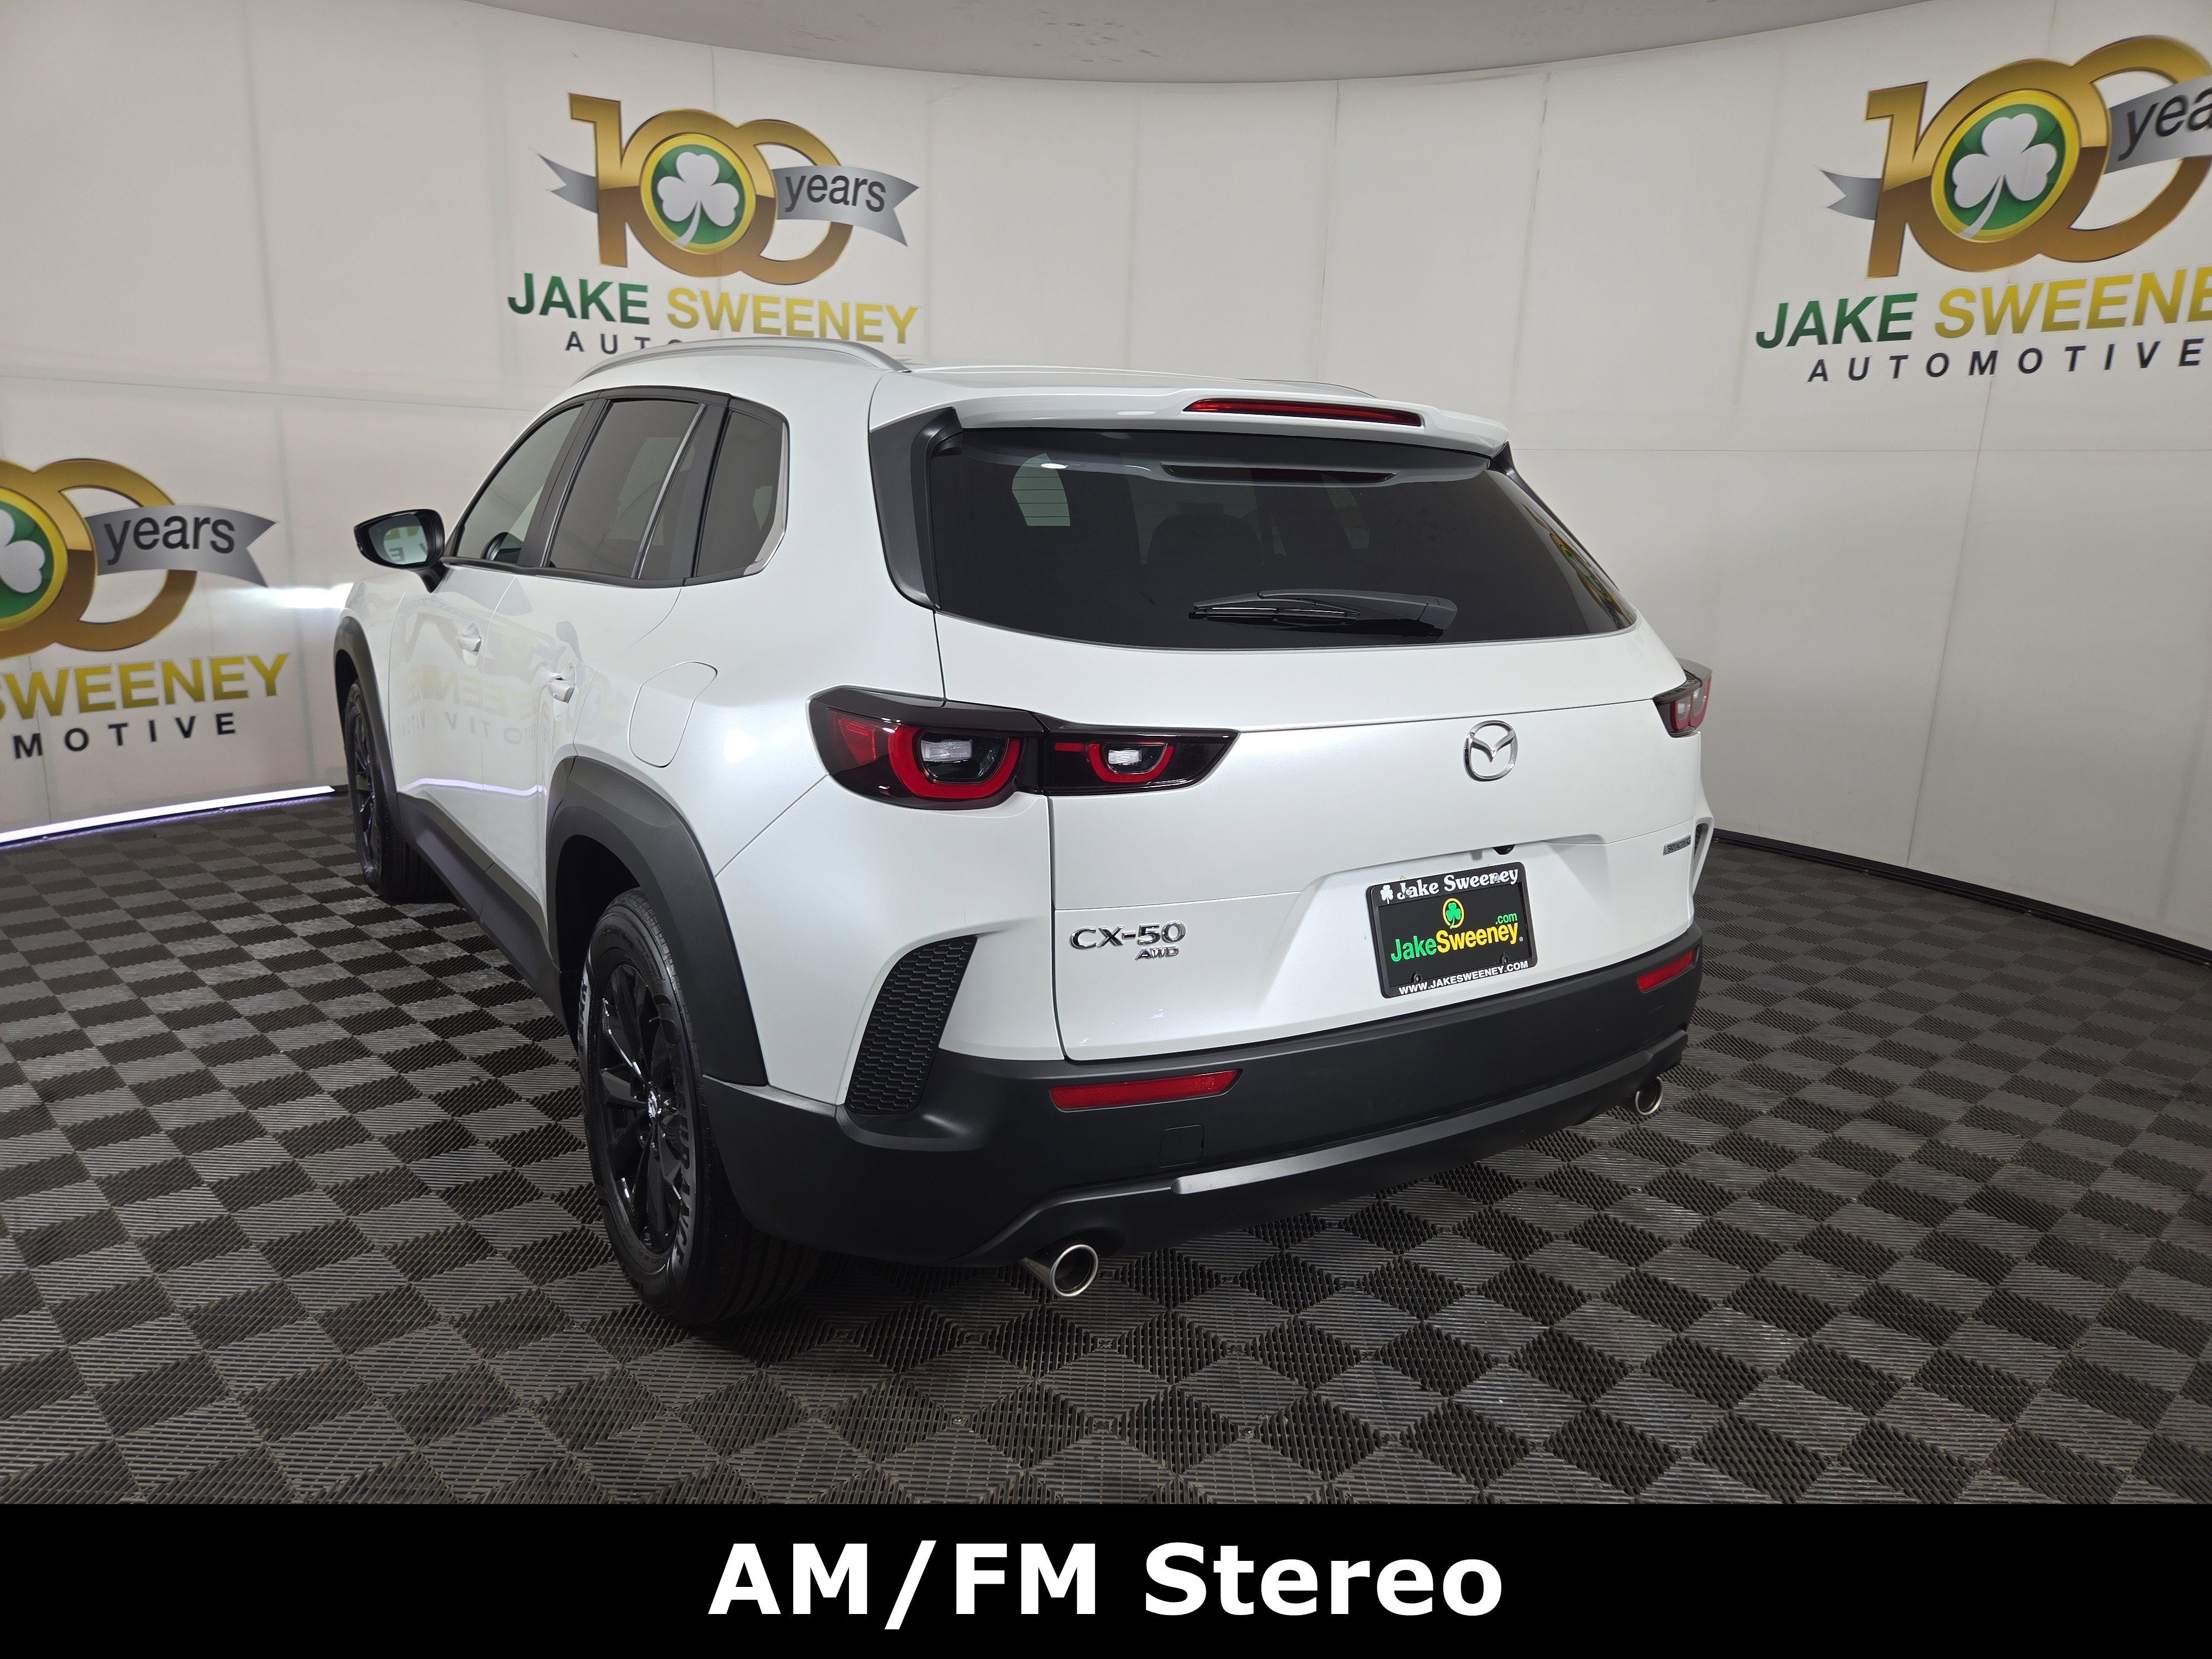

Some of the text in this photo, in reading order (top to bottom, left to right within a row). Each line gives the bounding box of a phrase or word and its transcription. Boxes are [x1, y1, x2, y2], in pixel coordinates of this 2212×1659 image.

[785, 173, 886, 213] years
[507, 273, 918, 344] JAKE SWEENEY
[1755, 293, 1919, 349] JAKE
[565, 331, 682, 355] AUT
[1807, 338, 2205, 382] AUTOMOTIVE
[103, 515, 235, 565] years
[1397, 869, 1519, 900] Jake Sweeney
[1070, 921, 1186, 949] CX-50
[1134, 946, 1179, 960] AWD
[1398, 960, 1528, 995] WWW.JAKESWEENEY.COM
